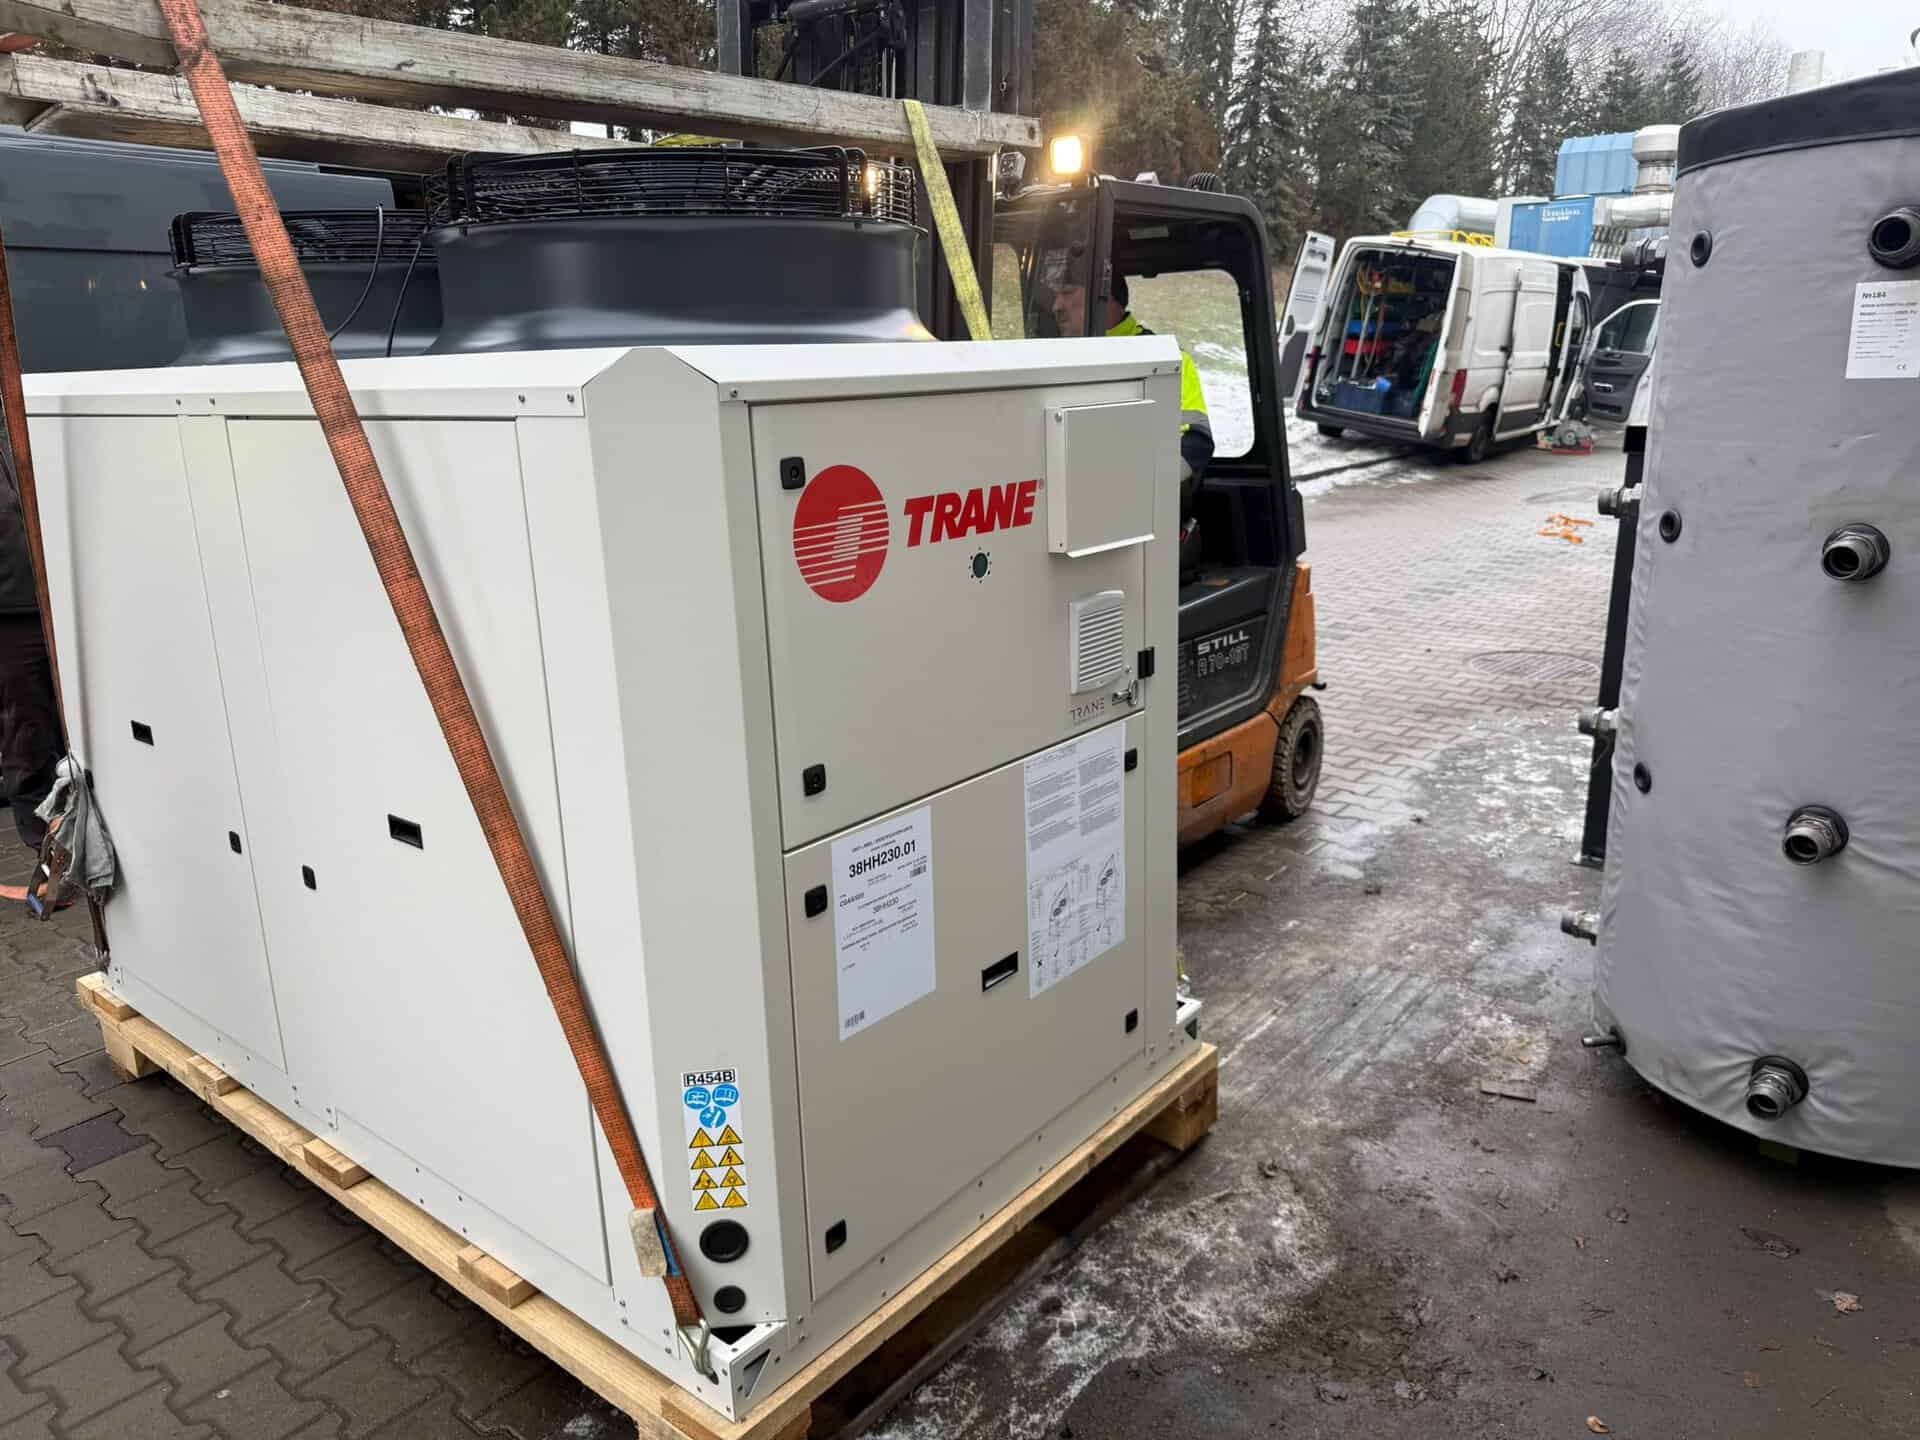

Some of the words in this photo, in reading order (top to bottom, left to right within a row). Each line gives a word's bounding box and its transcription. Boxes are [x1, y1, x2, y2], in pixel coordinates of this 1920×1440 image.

[904, 480, 1037, 547] TRANE
[1198, 630, 1248, 655] STILL
[1071, 697, 1105, 720] TRANE
[848, 839, 916, 878] 38HH230.01
[686, 1071, 733, 1086] R454B
